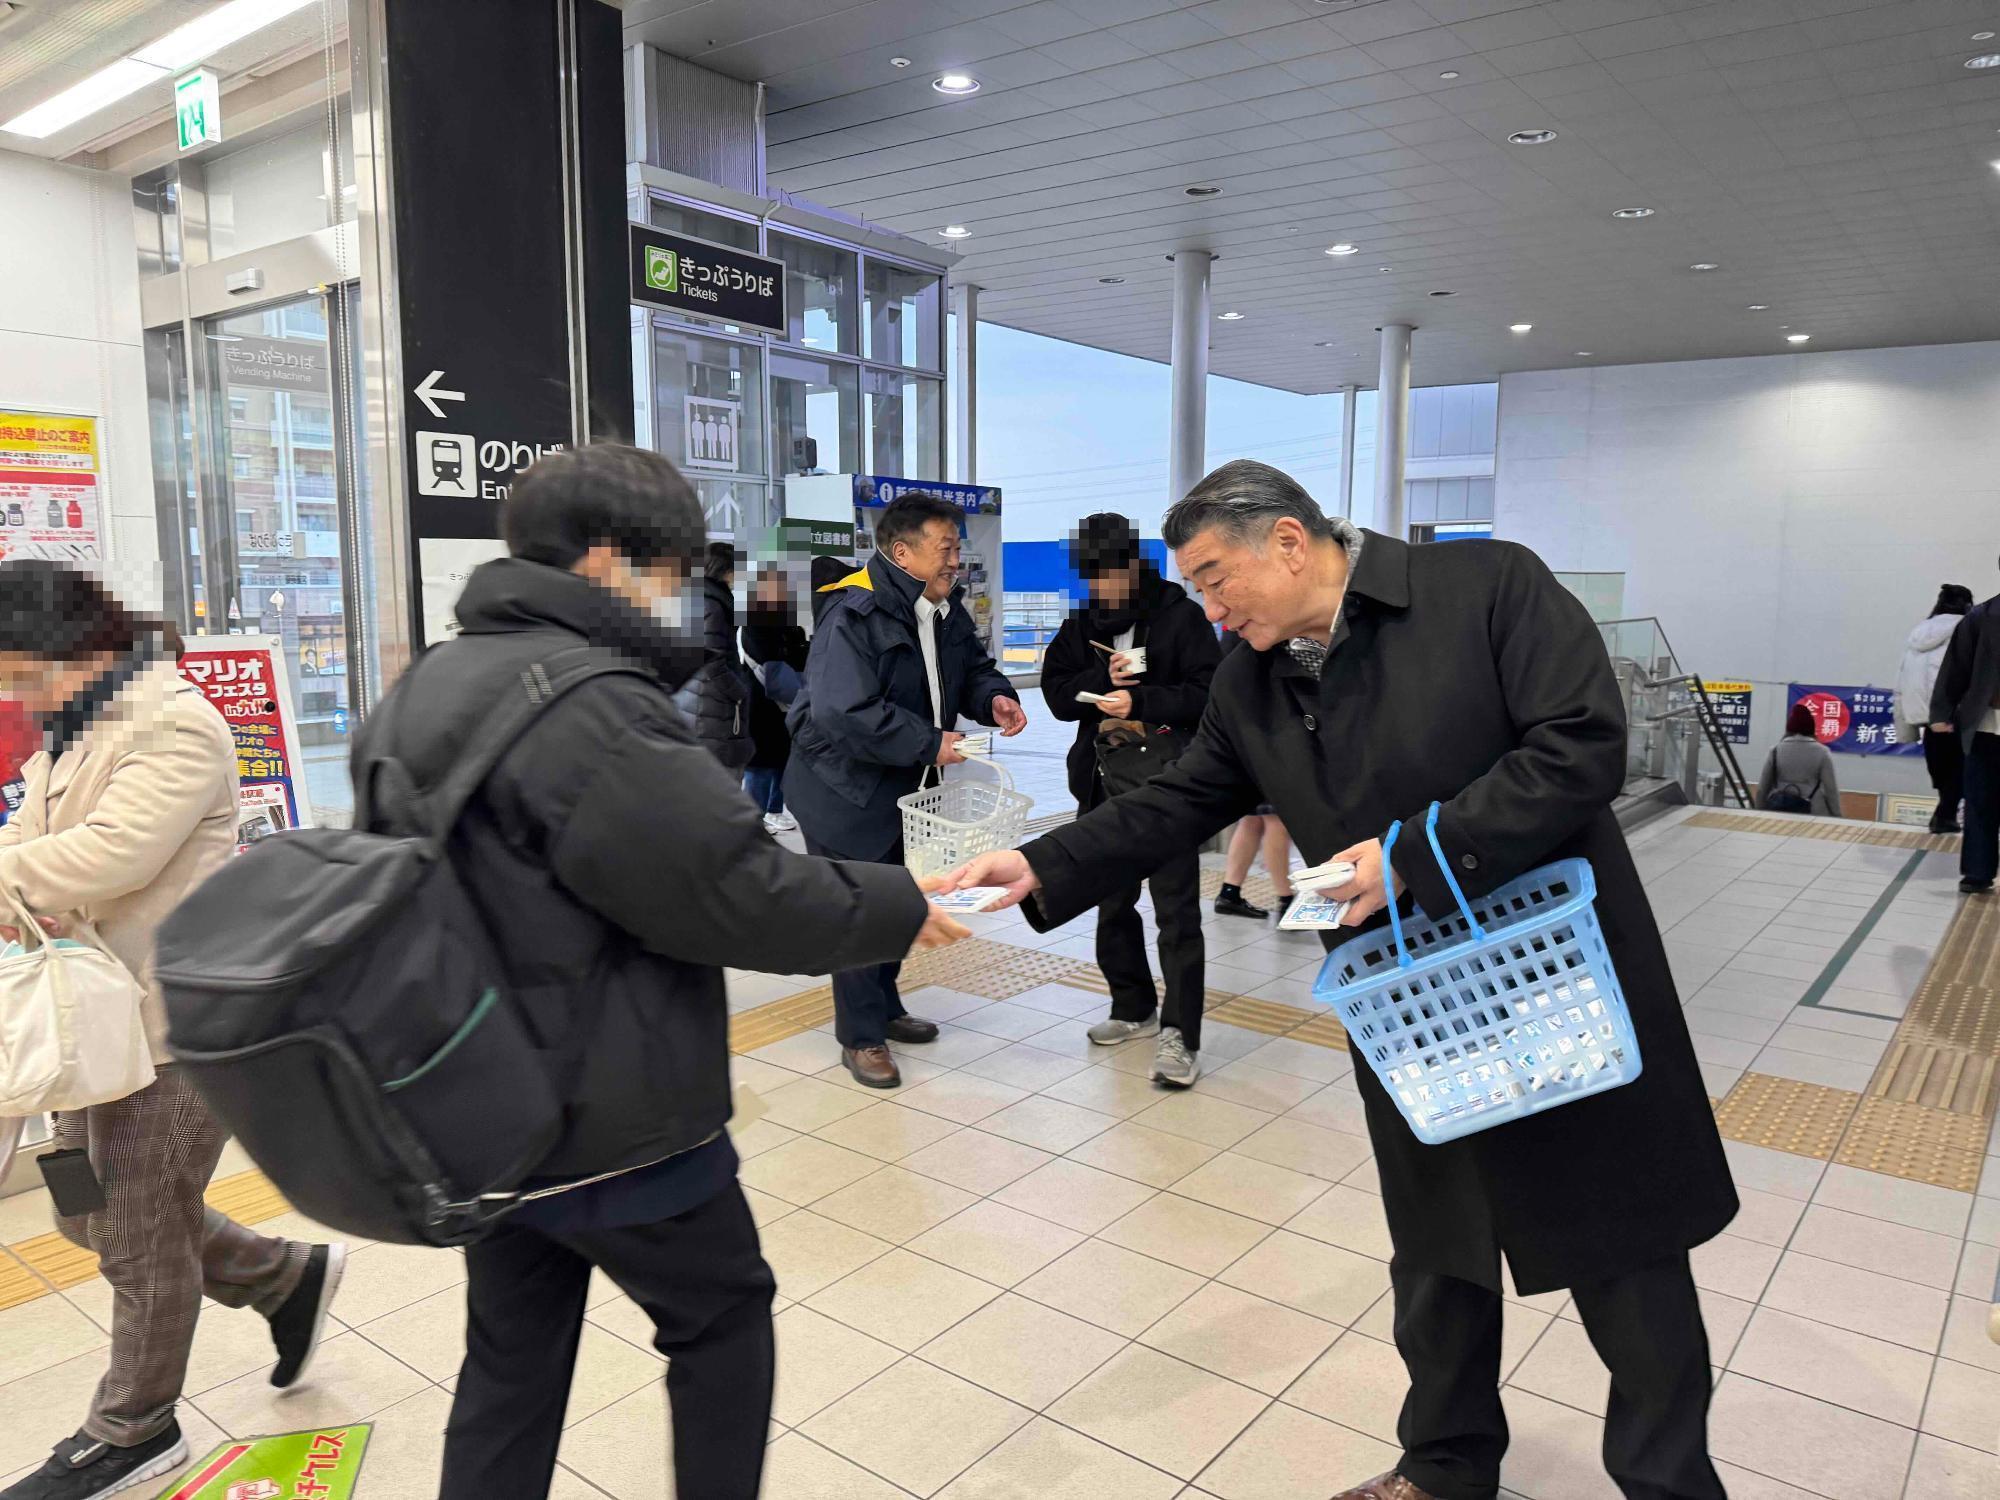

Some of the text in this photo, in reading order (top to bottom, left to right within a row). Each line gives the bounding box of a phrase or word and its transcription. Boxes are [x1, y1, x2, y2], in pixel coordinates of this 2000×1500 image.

[680, 257, 774, 297] きっぷうりば
[681, 282, 718, 301] Tickets
[225, 346, 315, 369] きっぷうりば
[232, 365, 312, 382] Vending Machine
[810, 531, 850, 546] 立図書館
[207, 682, 267, 698] フェスタ
